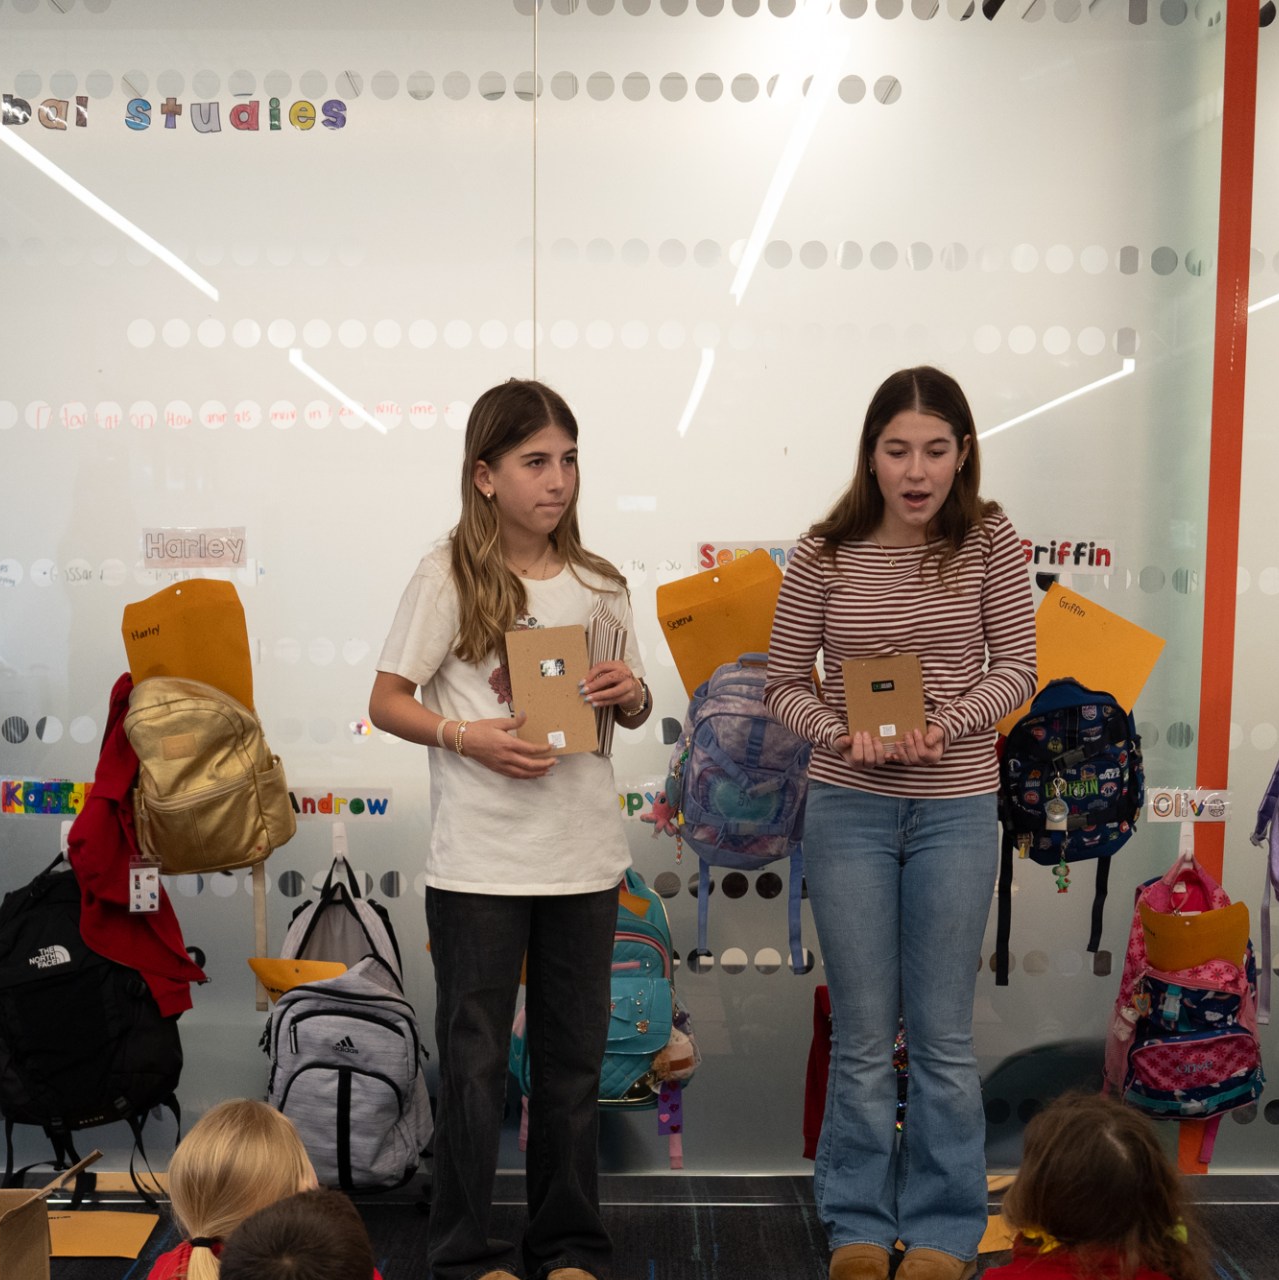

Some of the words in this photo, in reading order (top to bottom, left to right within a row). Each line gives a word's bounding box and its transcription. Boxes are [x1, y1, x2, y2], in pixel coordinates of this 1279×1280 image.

[145, 532, 245, 564] Harley
[1020, 539, 1111, 567] Griffin
[1058, 595, 1087, 618] Griffin
[1153, 792, 1226, 817] Olive
[29, 952, 56, 966] NORTH
[38, 946, 55, 957] THE
[37, 960, 58, 970] FACE
